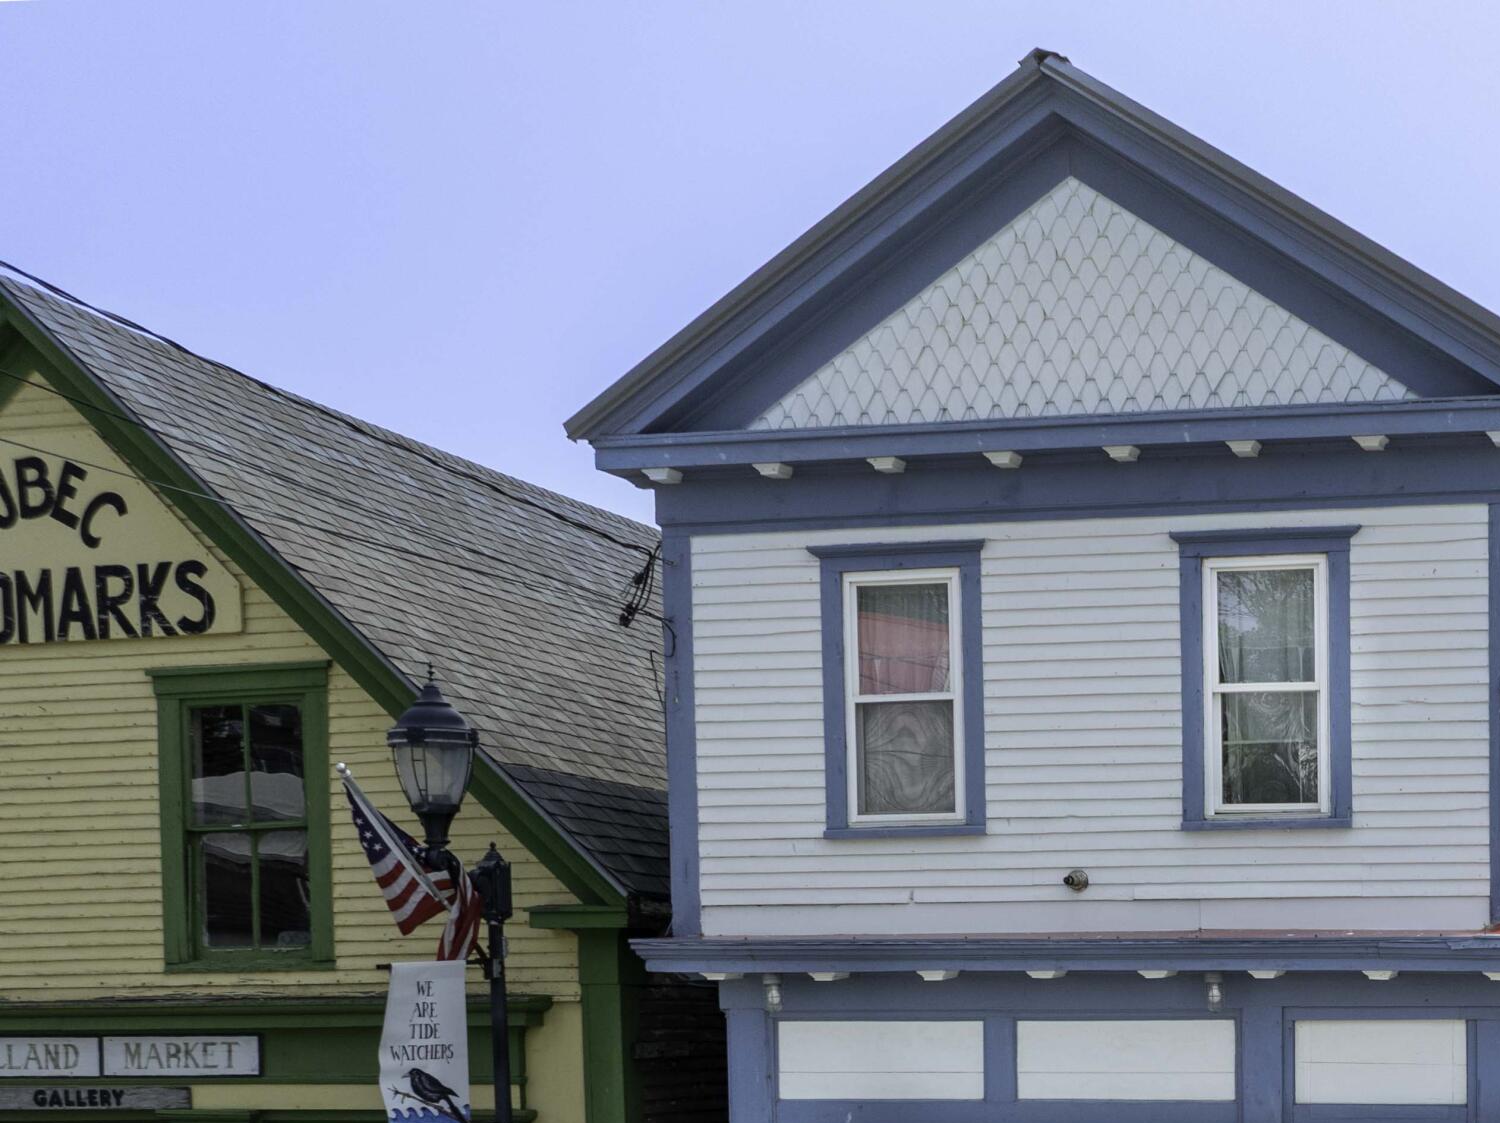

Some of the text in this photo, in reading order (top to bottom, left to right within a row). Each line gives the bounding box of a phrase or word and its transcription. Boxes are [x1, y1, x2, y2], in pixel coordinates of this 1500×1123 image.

[416, 981, 434, 997] WE
[410, 1001, 439, 1022] ARE
[409, 1023, 440, 1039] TIDE
[0, 1041, 241, 1071] LAND MARKET
[389, 1043, 455, 1065] WATCHERS
[33, 1089, 125, 1108] GALLERY
